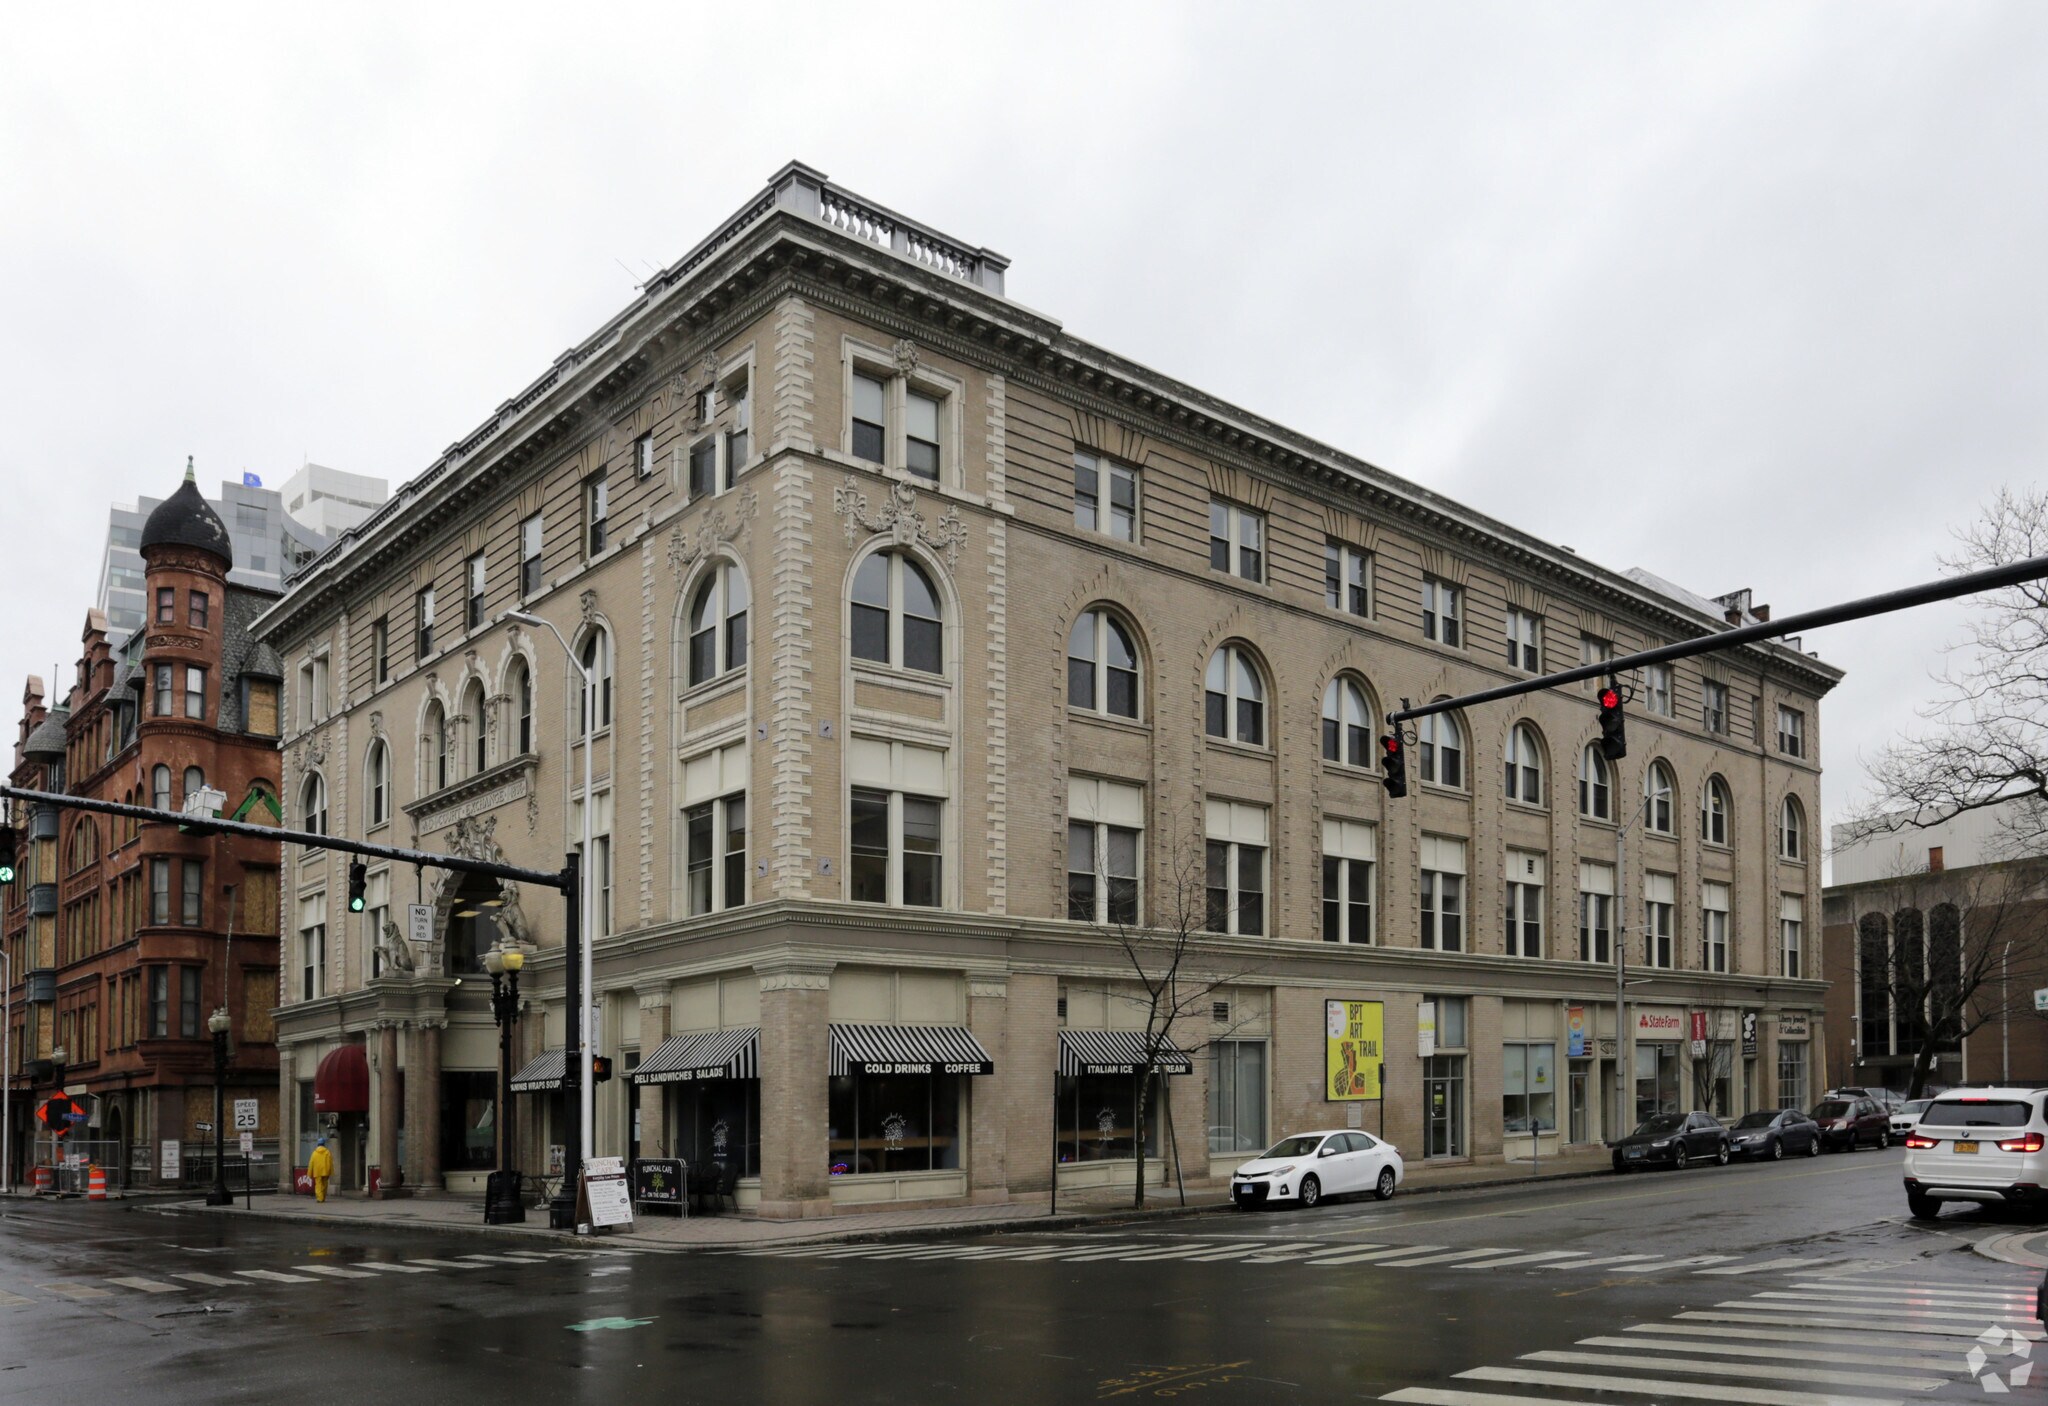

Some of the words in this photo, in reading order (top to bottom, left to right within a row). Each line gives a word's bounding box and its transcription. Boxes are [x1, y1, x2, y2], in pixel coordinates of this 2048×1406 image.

[415, 908, 427, 916] NO
[1350, 1004, 1363, 1020] BPT
[1350, 1022, 1363, 1039] ART
[1358, 1040, 1378, 1057] TRAIL
[864, 1063, 892, 1073] COLD
[894, 1063, 932, 1073] DRINKS
[945, 1063, 981, 1073] COFFEE
[1087, 1064, 1118, 1074] ITALIAN
[1120, 1064, 1133, 1073] ICE
[1165, 1064, 1186, 1073] REAM
[634, 1074, 649, 1084] DELI
[650, 1070, 692, 1083] SANDWICHES
[696, 1067, 724, 1079] SALADS
[510, 1082, 528, 1092] ANINIS
[528, 1081, 546, 1090] WRAPS
[546, 1079, 560, 1089] SOUP
[237, 1114, 256, 1126] 25
[642, 1164, 661, 1173] FUNCHAL
[662, 1165, 673, 1174] CAFE
